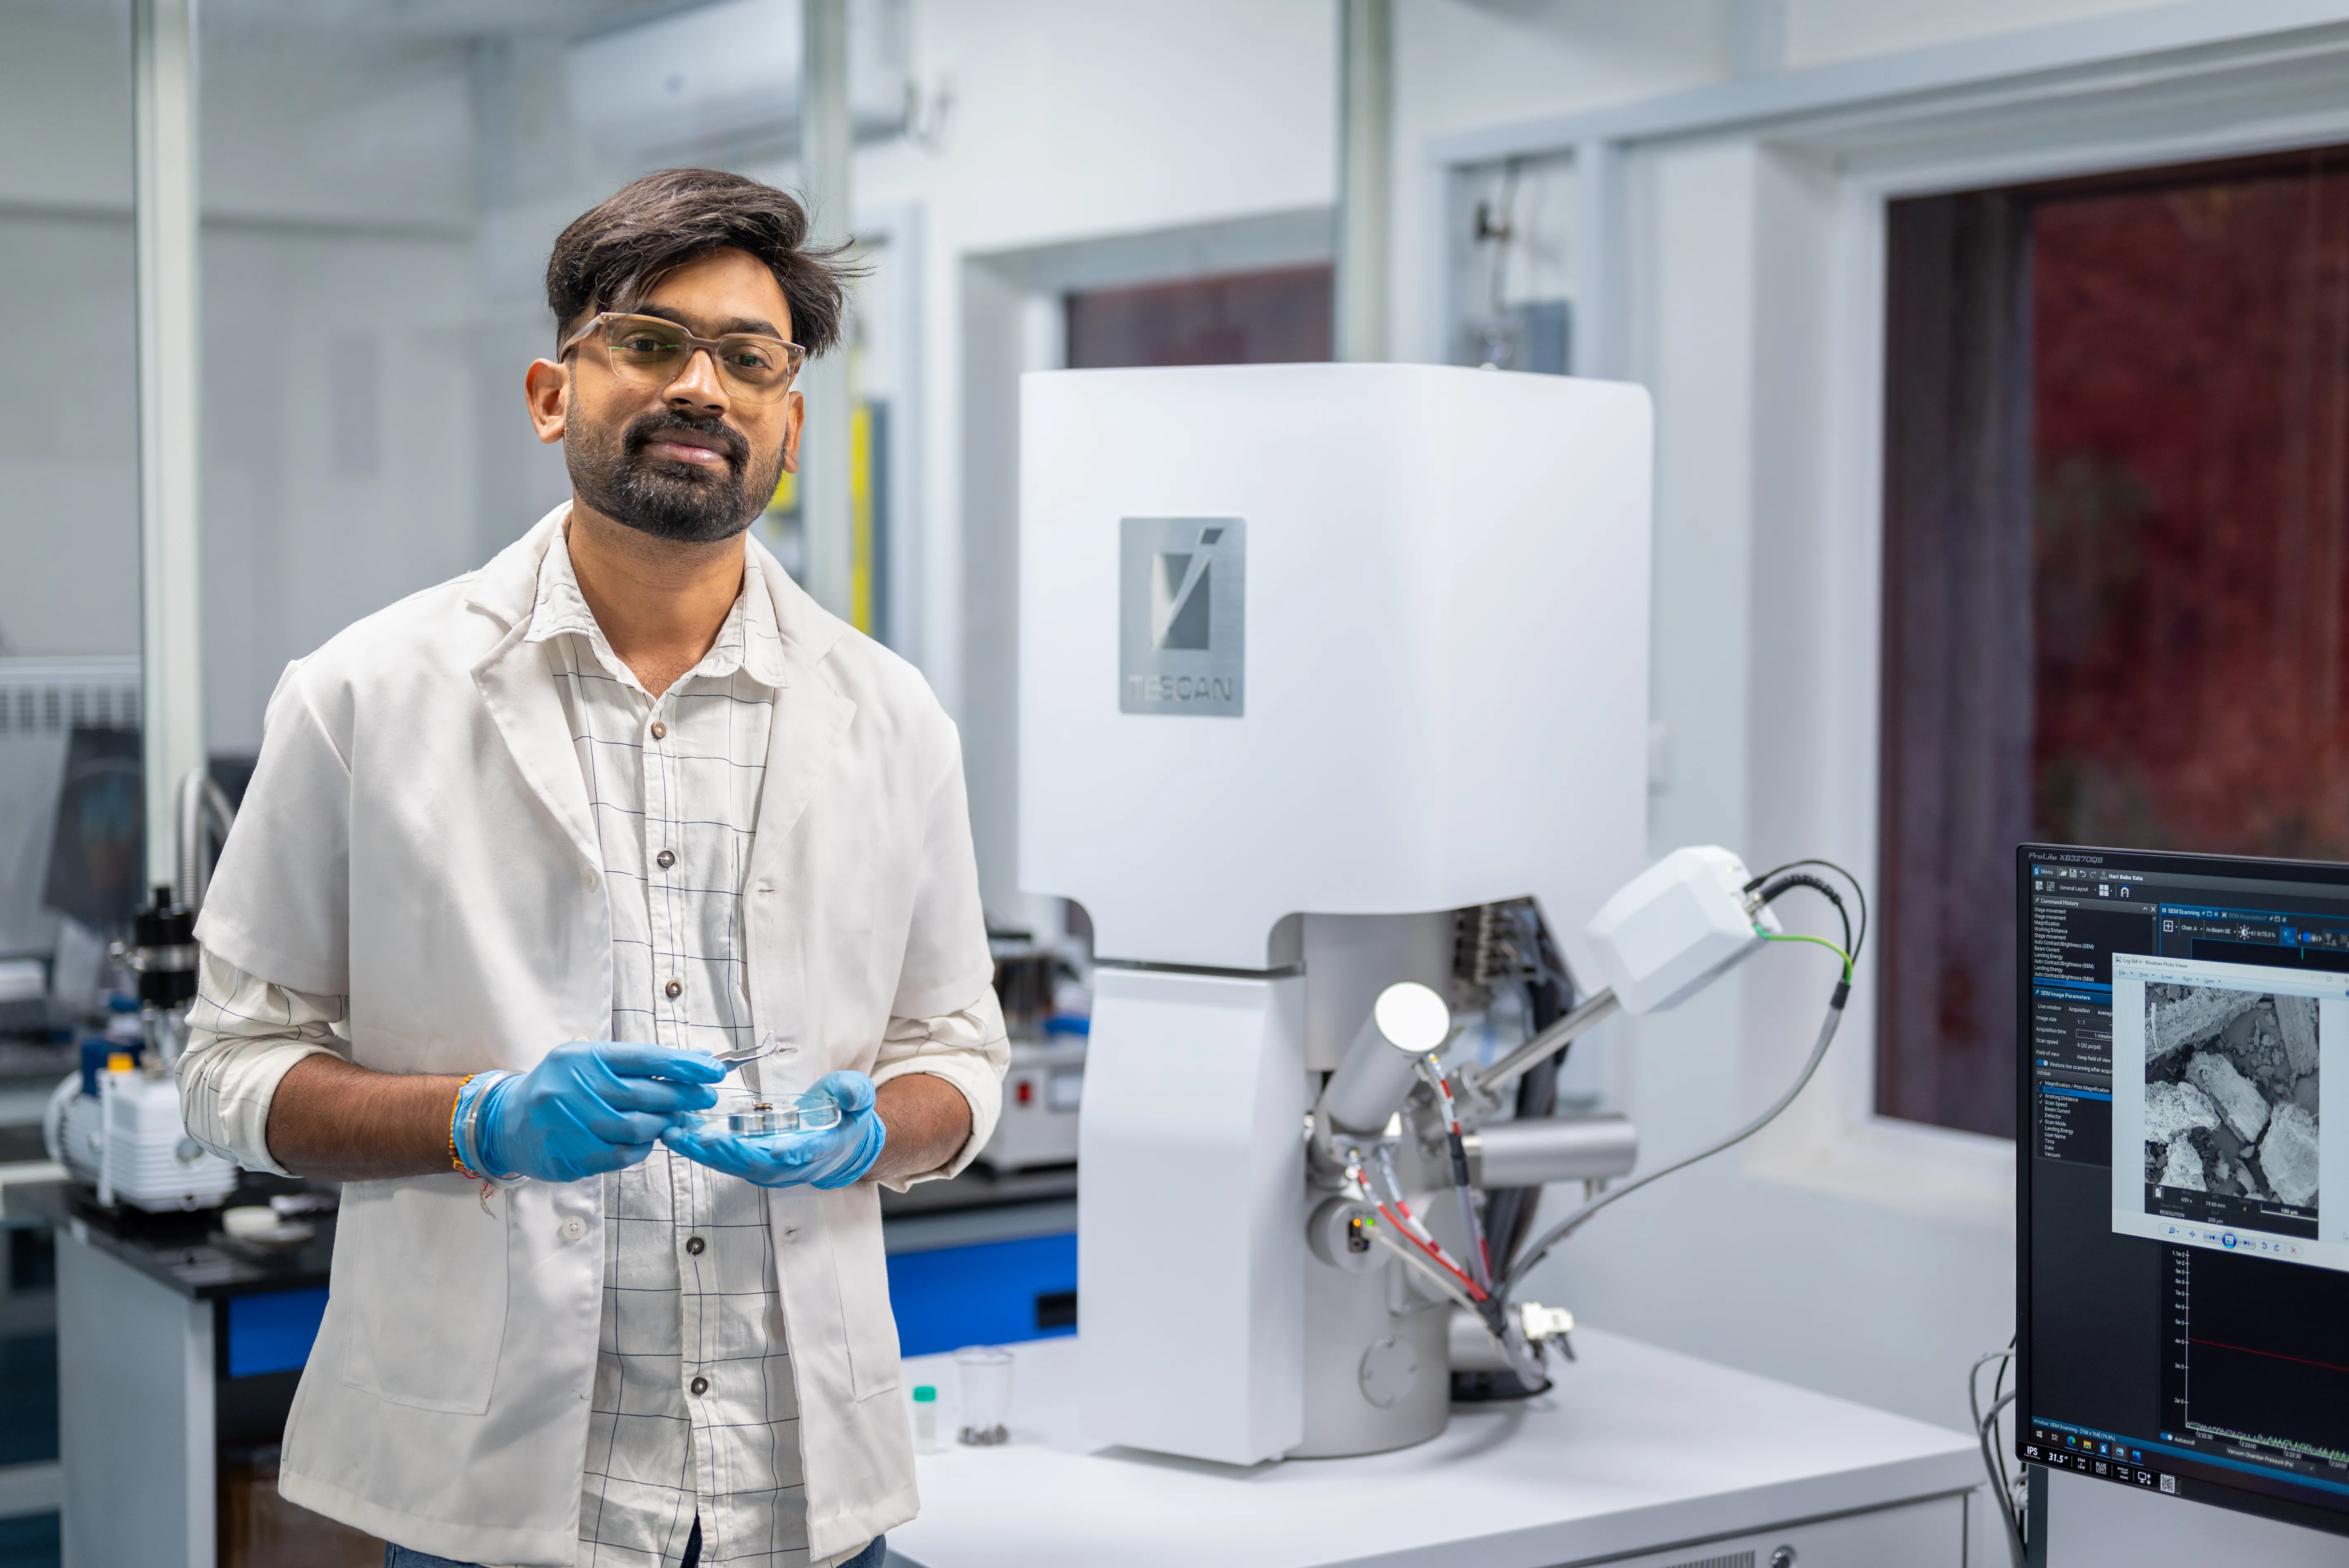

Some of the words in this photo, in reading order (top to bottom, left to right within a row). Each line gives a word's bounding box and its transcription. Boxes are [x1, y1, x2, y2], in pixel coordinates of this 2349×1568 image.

[1128, 674, 1233, 702] TESCAN
[2059, 854, 2103, 864] XB3270QS
[2160, 1210, 2185, 1218] RESOLUTION
[2060, 1424, 2077, 1434] Scanning
[2101, 1433, 2116, 1442] (79.8%)
[2195, 1432, 2213, 1440] 12:22:30
[2175, 1437, 2195, 1445] Autoscroll
[2027, 1446, 2037, 1456] IPS
[2227, 1448, 2245, 1457] Vacuum
[2245, 1452, 2264, 1461] Chamber
[2265, 1456, 2284, 1465] Pressure
